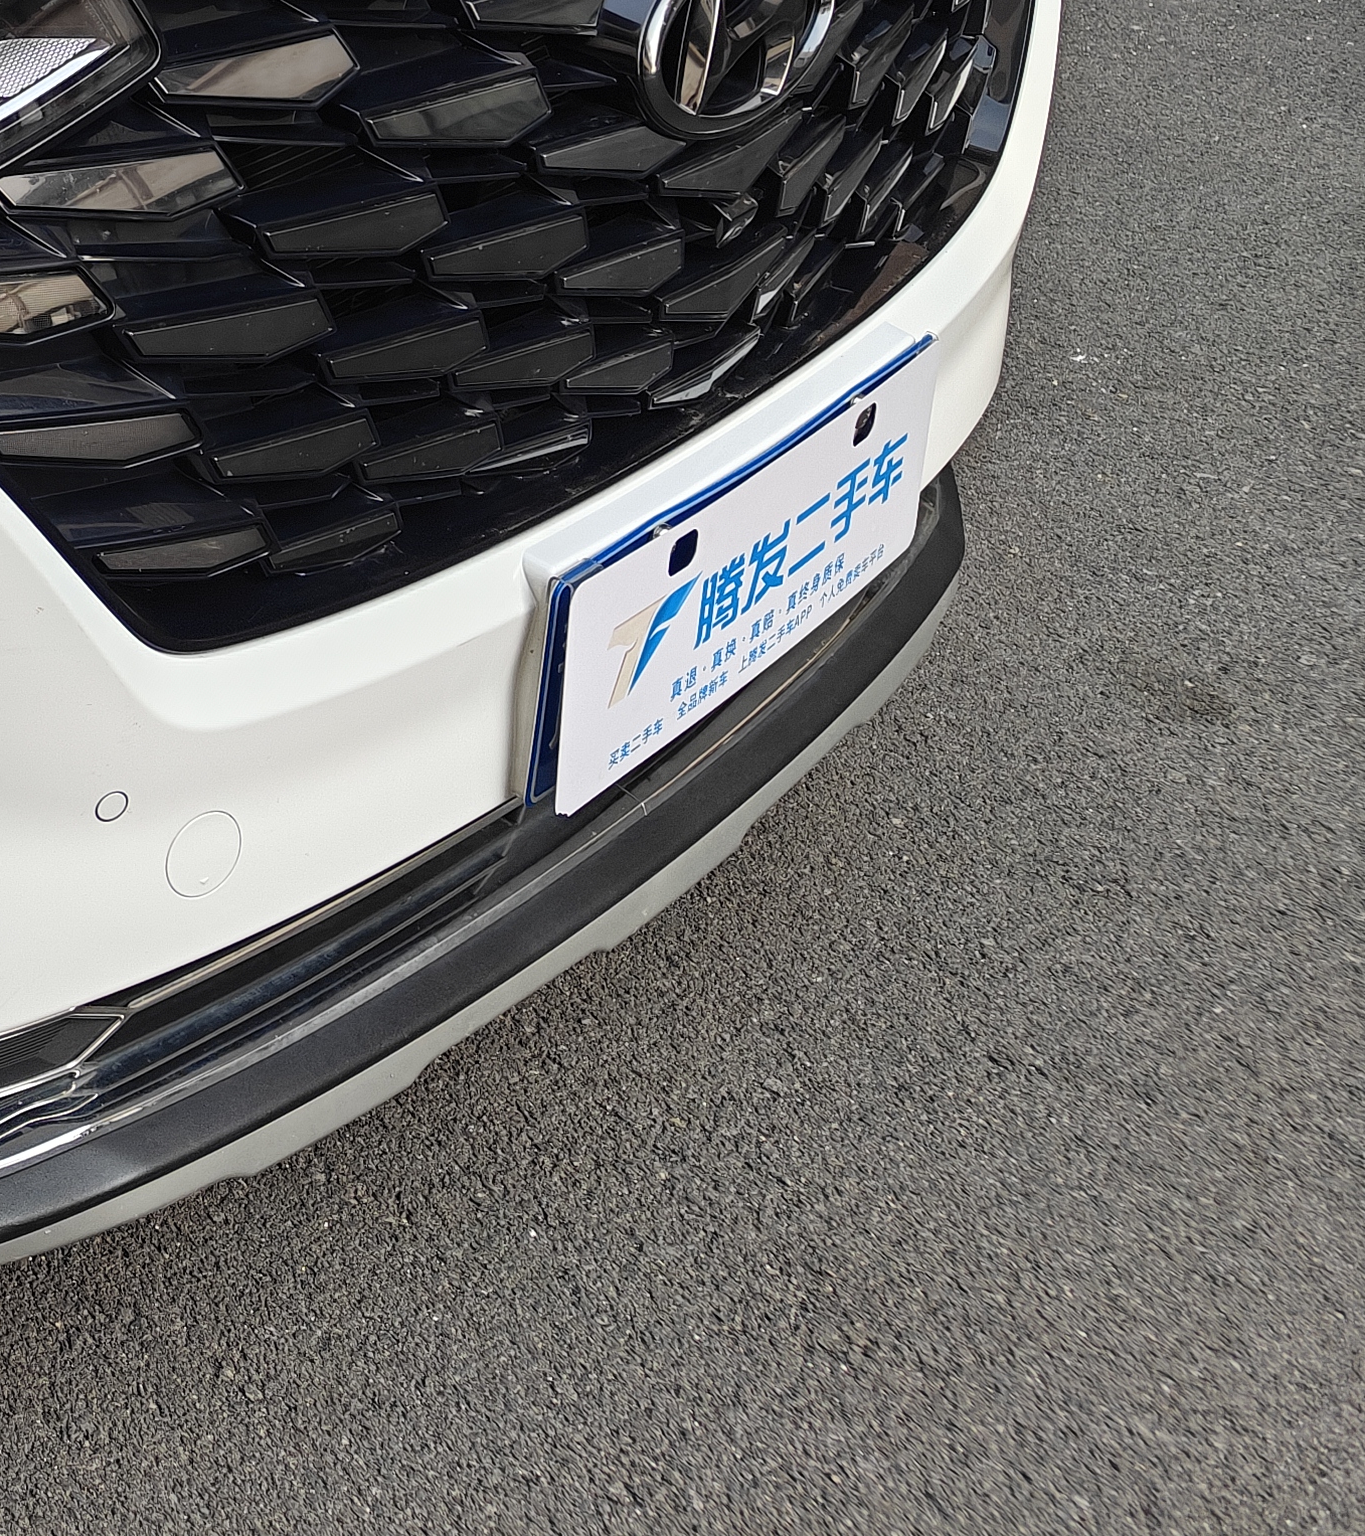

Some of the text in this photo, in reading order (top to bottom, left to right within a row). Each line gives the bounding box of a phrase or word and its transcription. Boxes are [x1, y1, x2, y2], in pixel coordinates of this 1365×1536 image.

[693, 433, 908, 651] 腾发二手车
[676, 670, 729, 721] 全品牌新车
